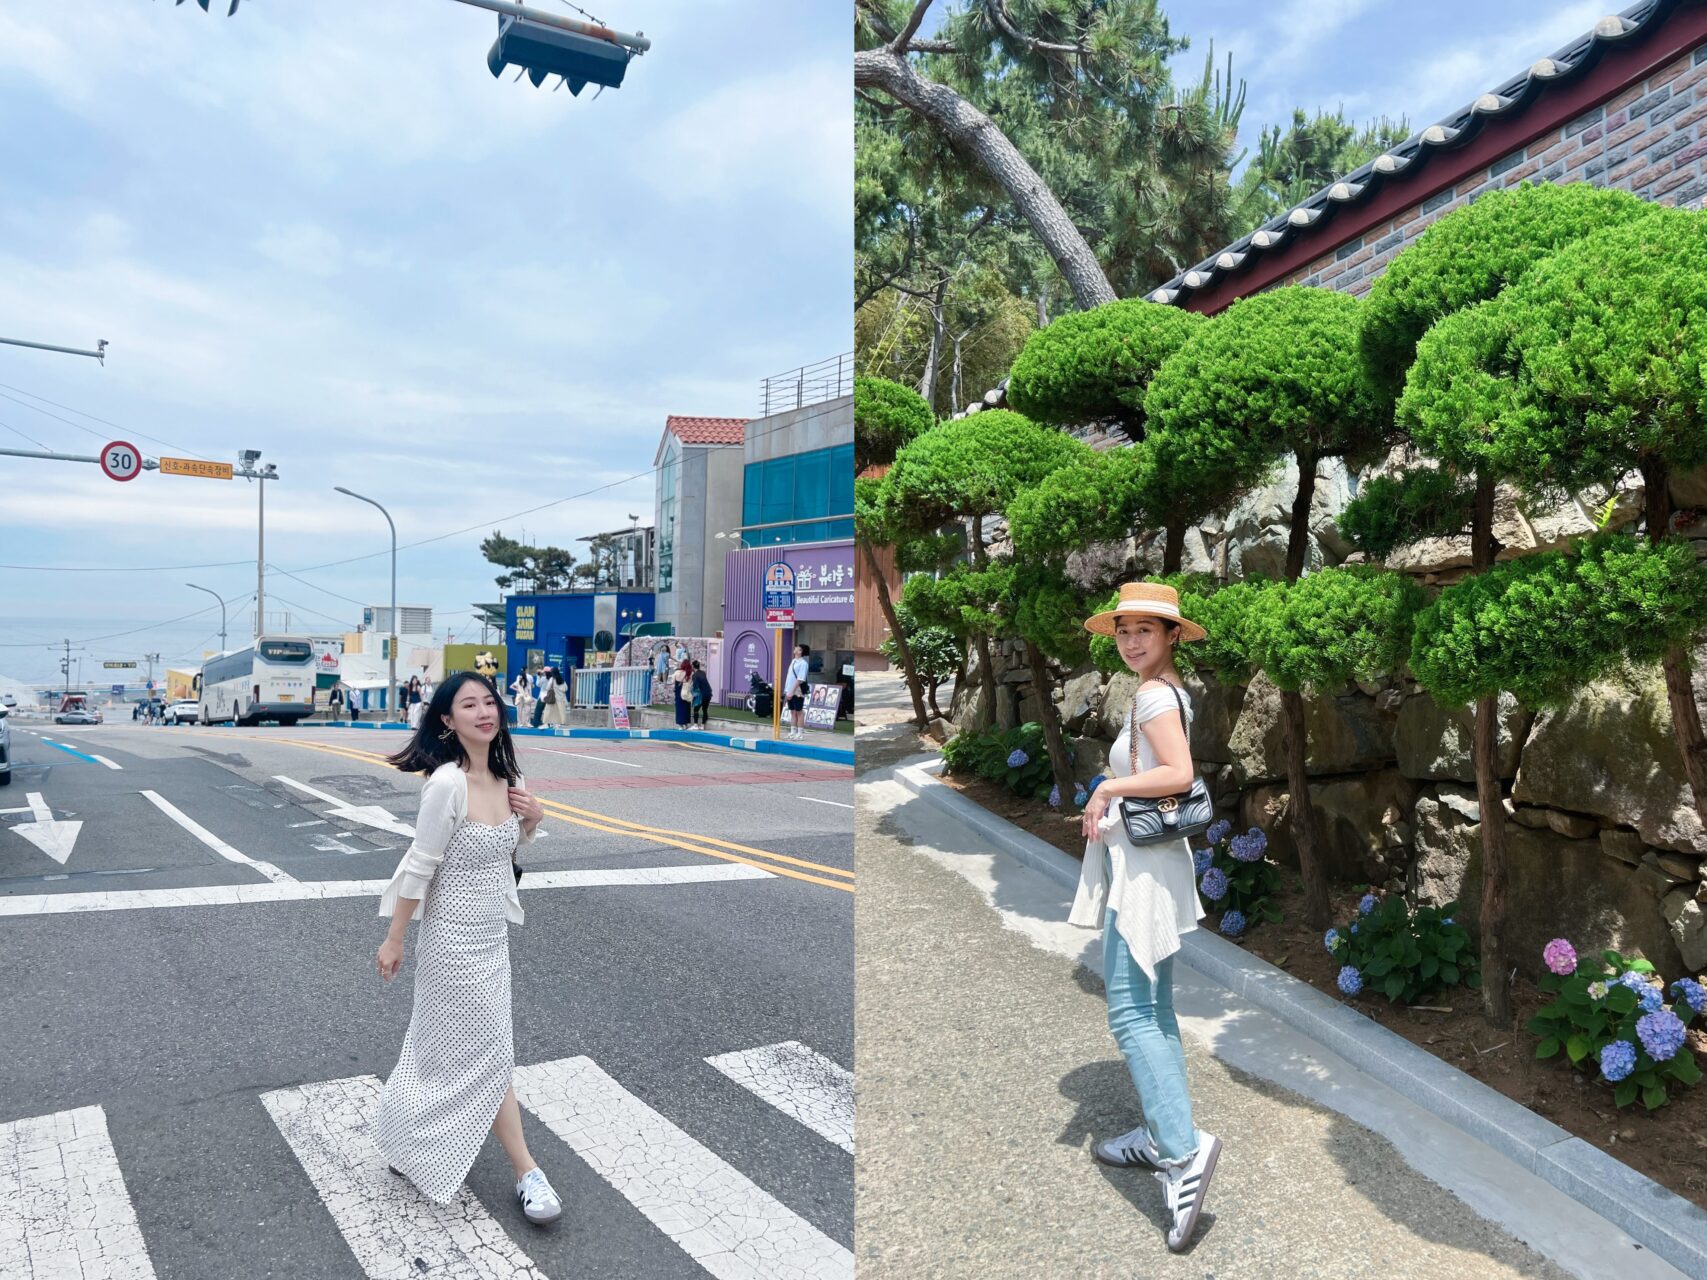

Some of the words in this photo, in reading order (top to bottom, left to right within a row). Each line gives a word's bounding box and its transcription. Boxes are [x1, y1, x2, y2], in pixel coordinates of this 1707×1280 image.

[110, 452, 132, 470] 30
[818, 564, 844, 587] 뷰티플
[796, 595, 819, 604] Beautiful
[820, 595, 847, 604] Caricature
[516, 605, 535, 618] GLAM
[516, 618, 534, 629] SAND
[267, 648, 283, 656] VIP
